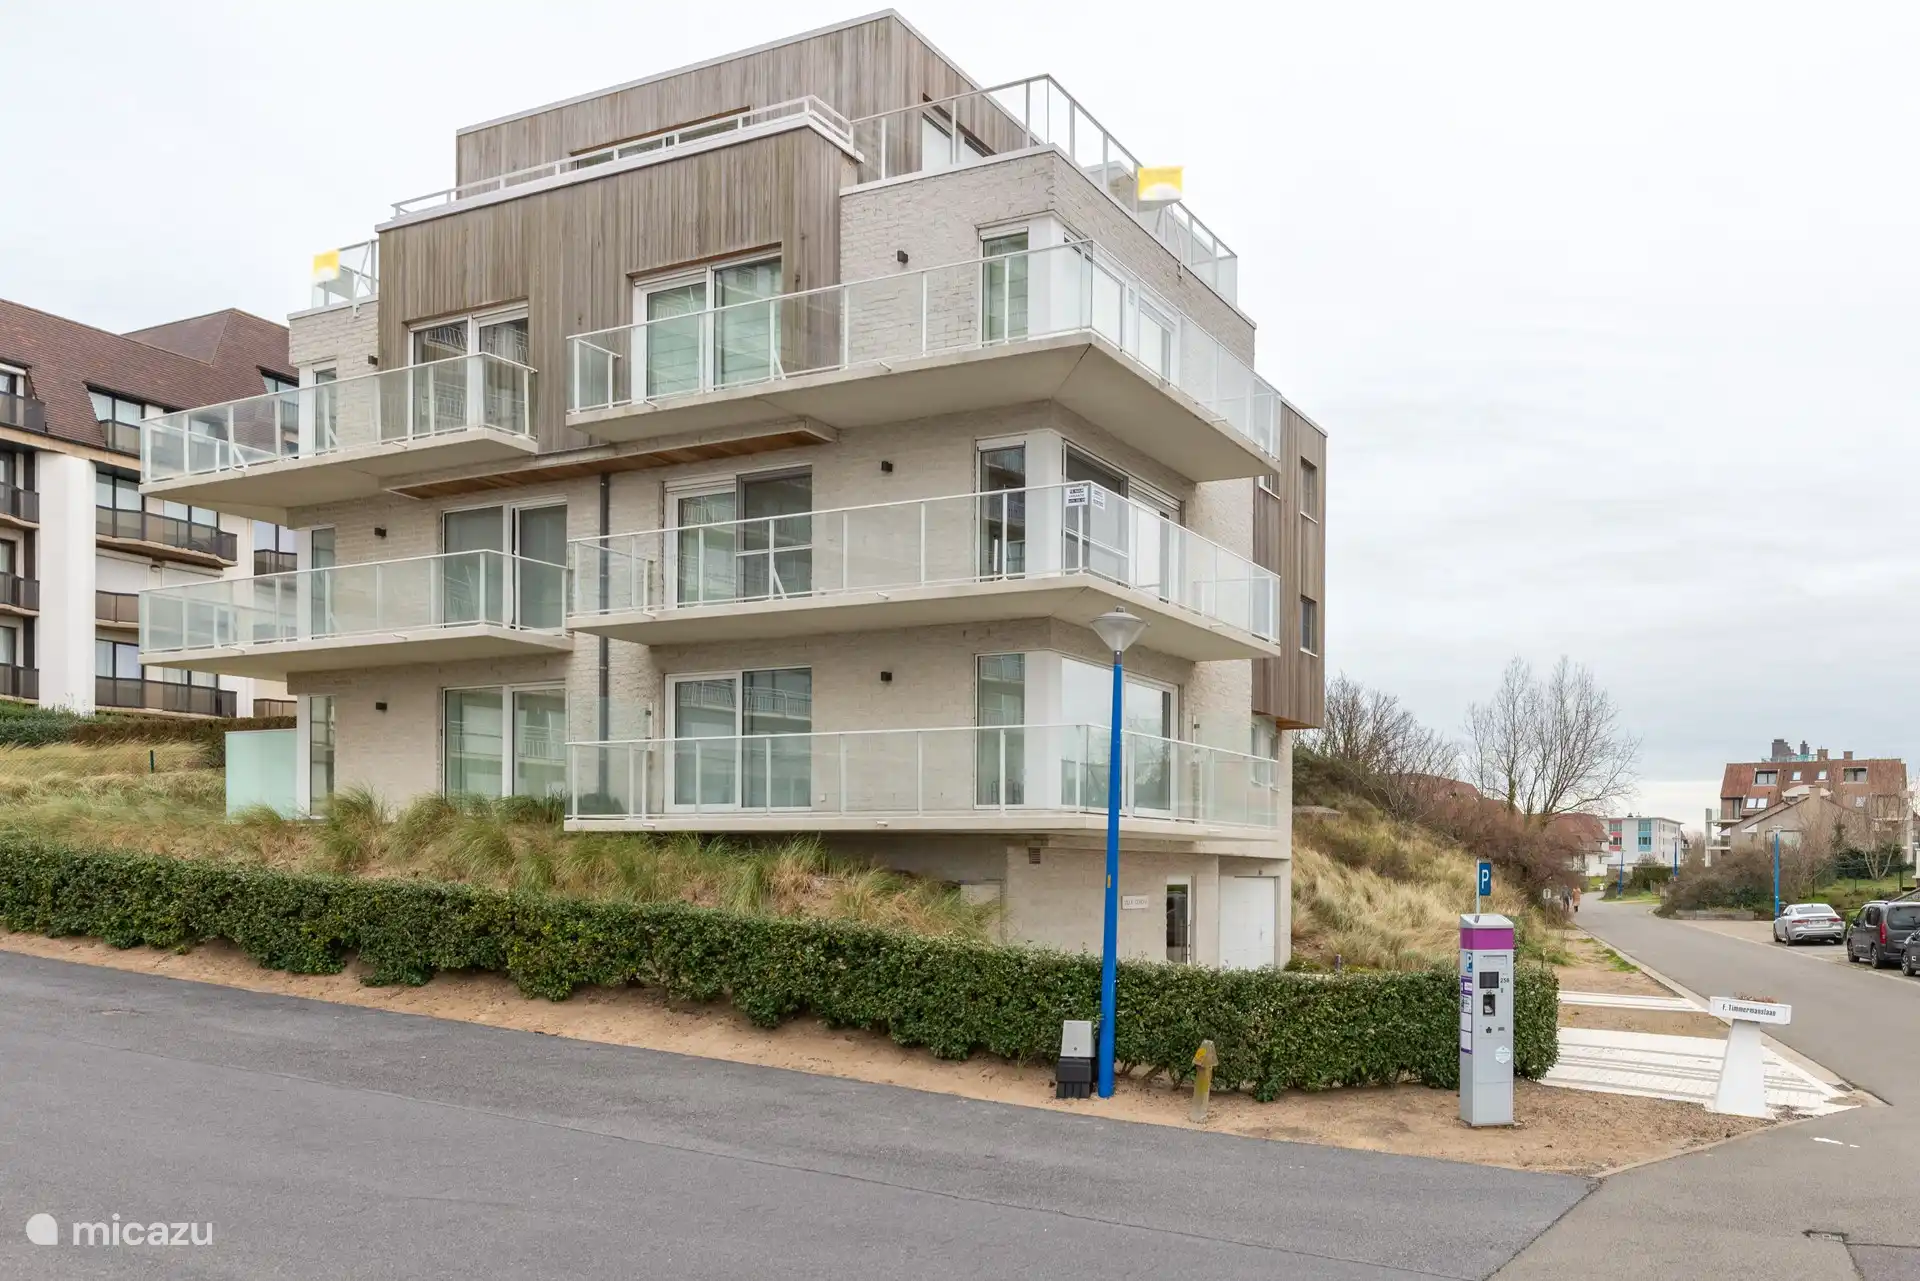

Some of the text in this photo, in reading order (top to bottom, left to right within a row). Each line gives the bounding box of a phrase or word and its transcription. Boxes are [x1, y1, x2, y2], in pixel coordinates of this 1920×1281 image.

[1481, 869, 1489, 889] P
[1722, 1003, 1777, 1017] F. Timmermanslaan
